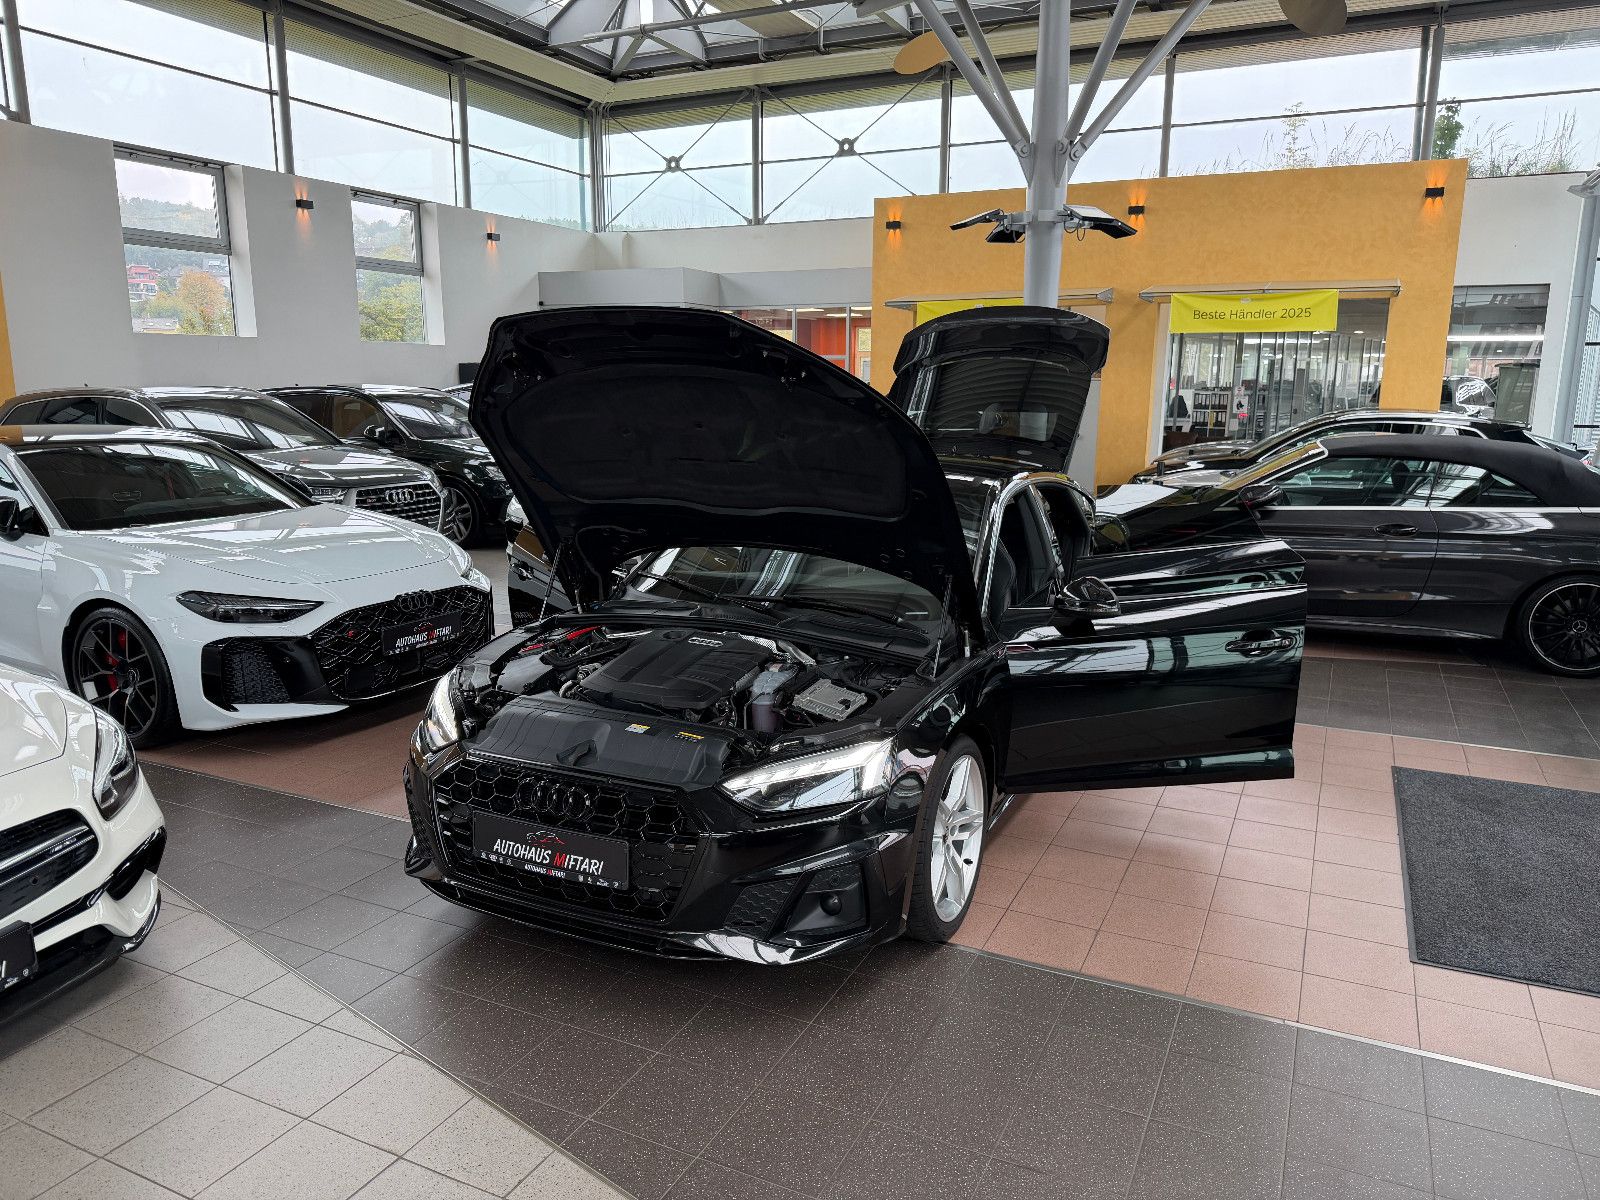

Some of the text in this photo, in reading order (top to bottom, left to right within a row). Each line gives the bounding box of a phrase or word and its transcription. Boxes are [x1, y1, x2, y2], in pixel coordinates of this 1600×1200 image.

[1193, 307, 1312, 320] Beste Händler 2025
[395, 632, 428, 647] AUTOHAUS
[428, 626, 452, 639] MIFTARI
[493, 838, 604, 875] AUTOHAUS MIFTARI
[524, 863, 566, 879] AUTOHAUS MIFTARI
